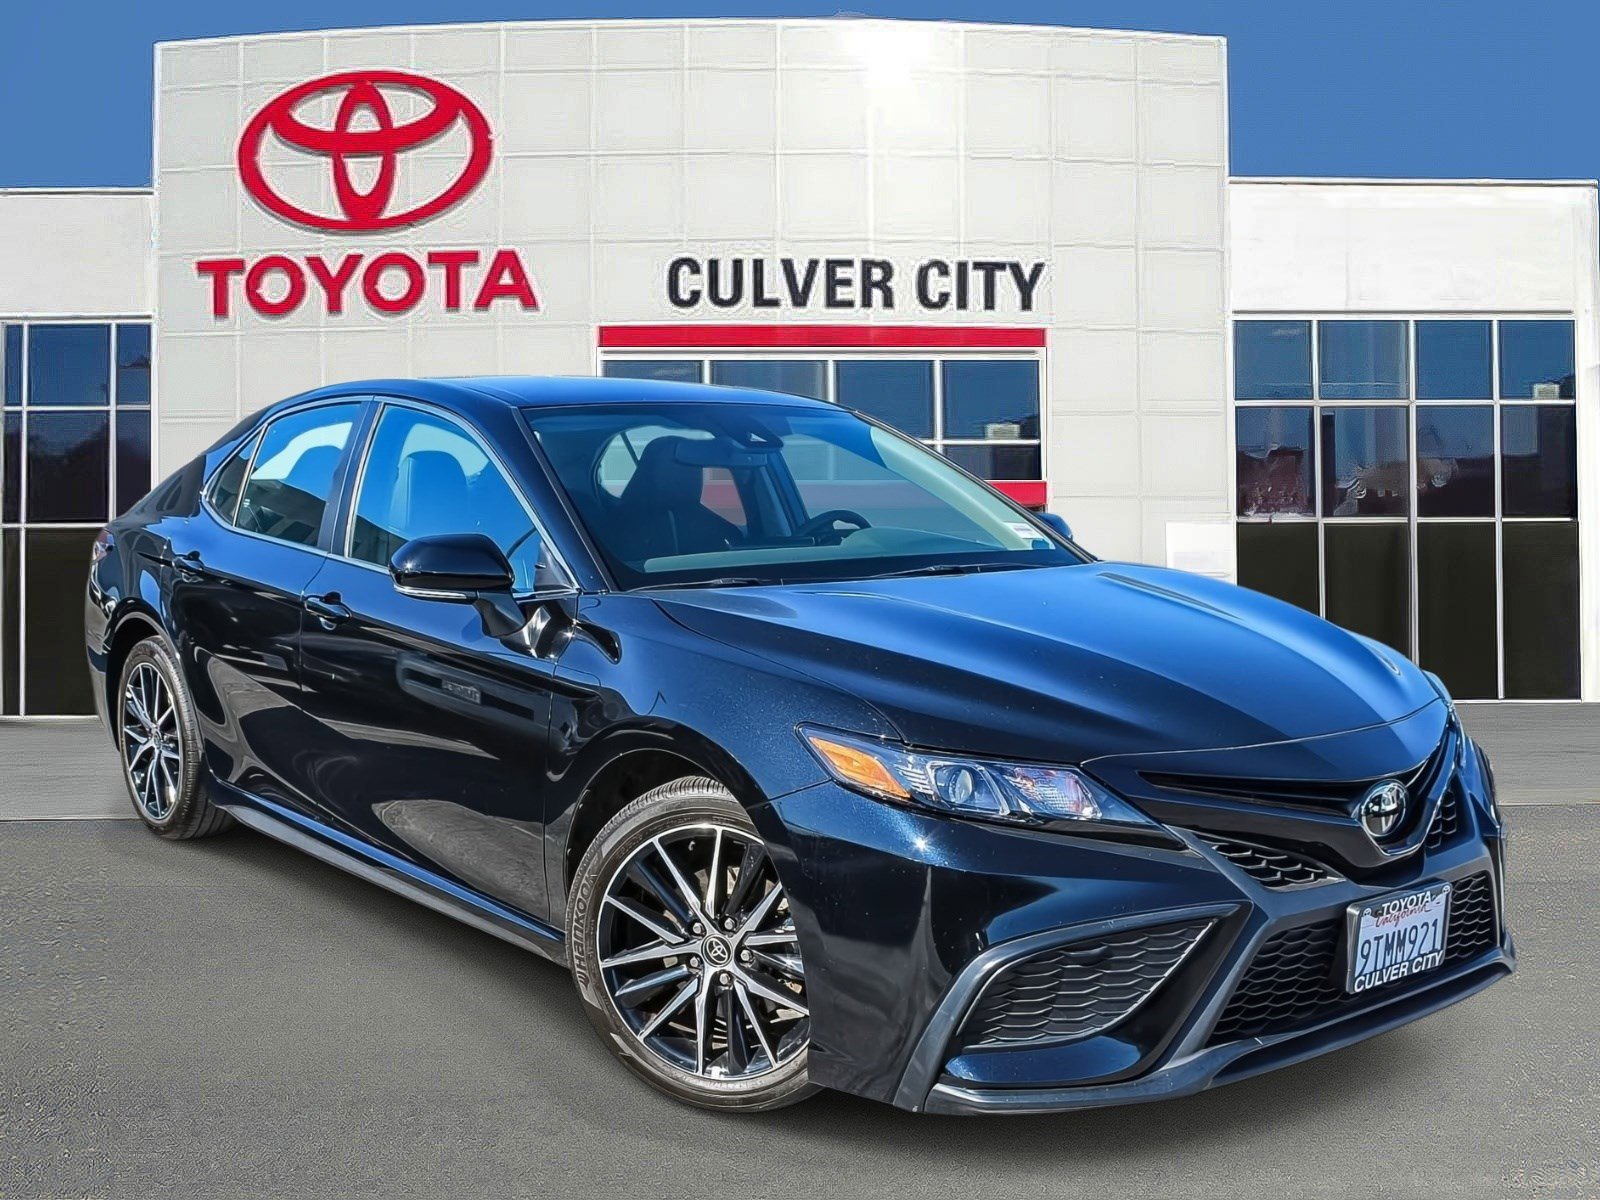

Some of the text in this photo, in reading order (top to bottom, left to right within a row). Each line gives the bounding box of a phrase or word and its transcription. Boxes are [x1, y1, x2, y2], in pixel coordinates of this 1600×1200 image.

[195, 249, 540, 318] TOYOTA
[668, 257, 1045, 311] CULVER CITY
[1382, 891, 1431, 917] TOYOTA
[1354, 950, 1444, 993] CULVER CITY
[1360, 918, 1438, 975] 9TMM921
